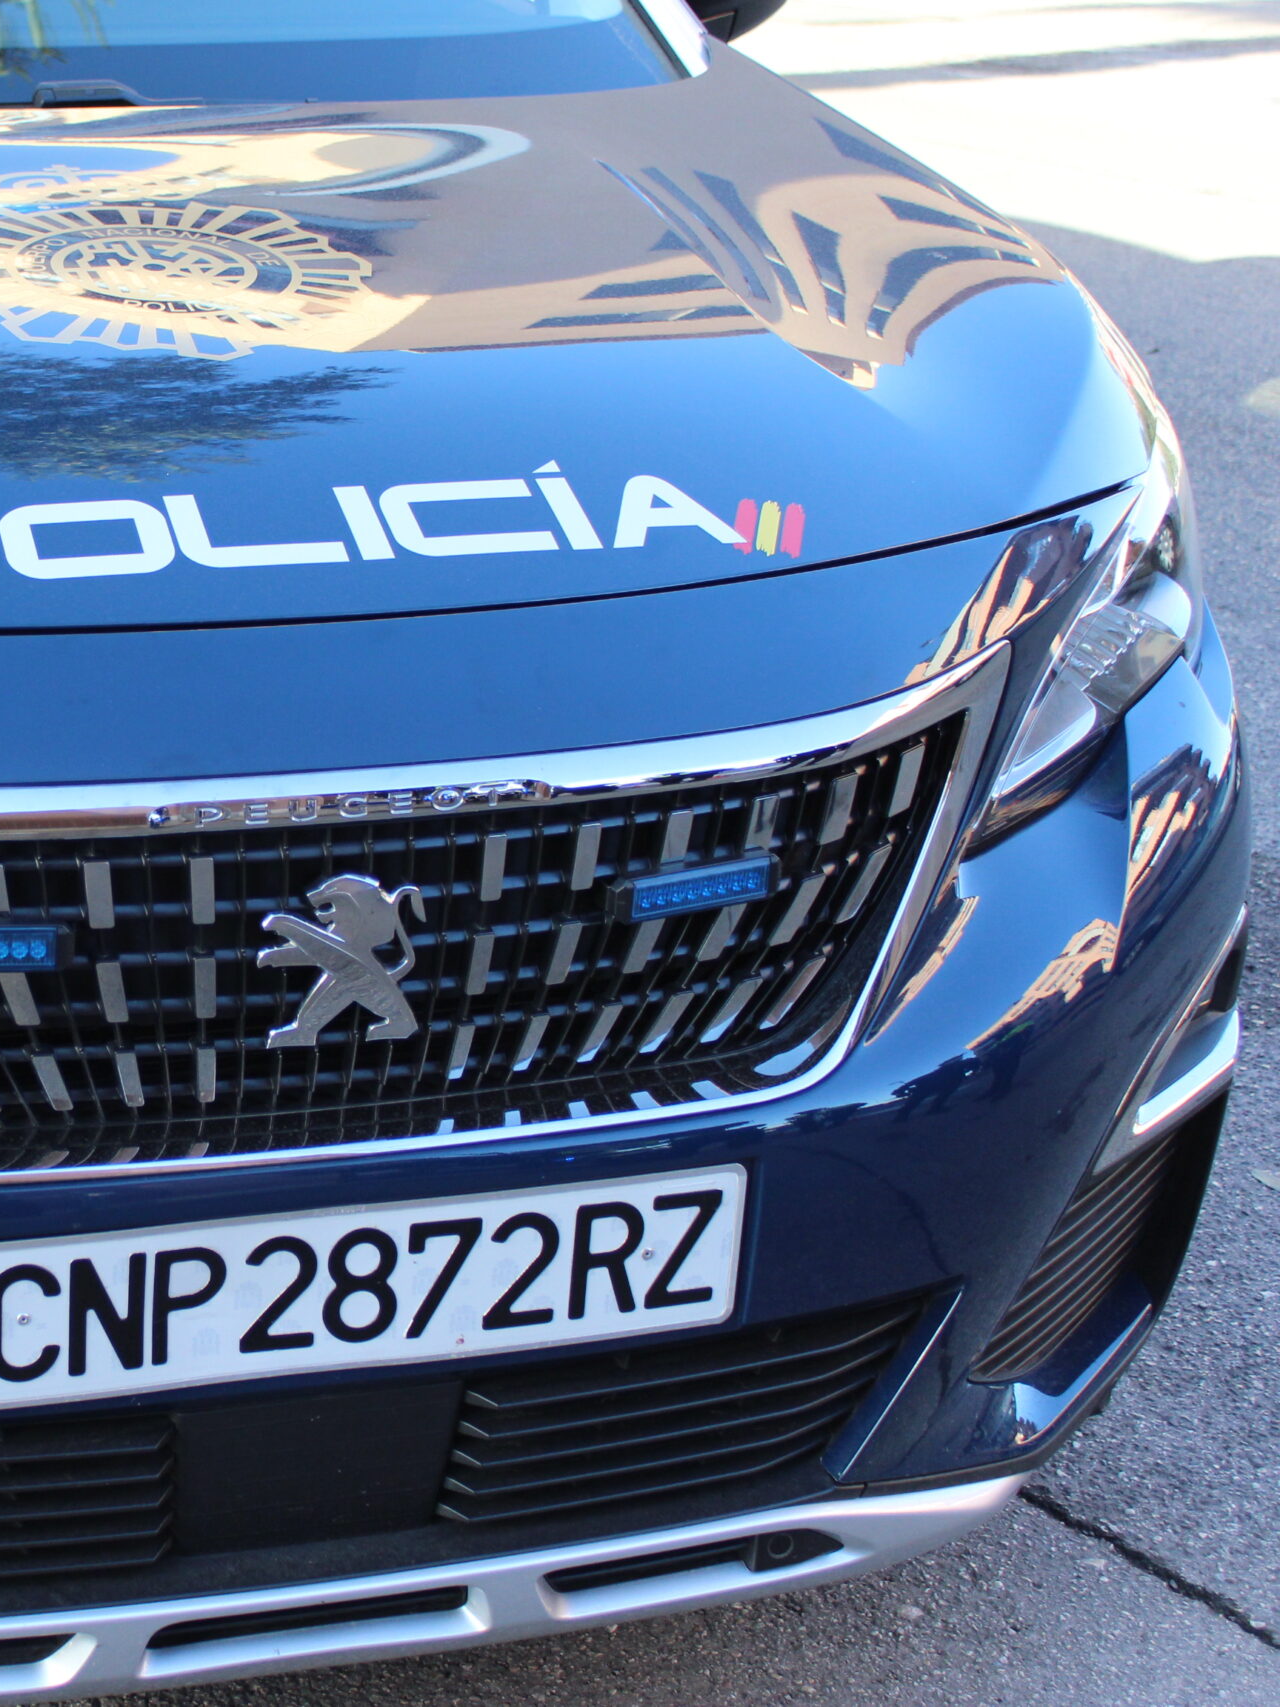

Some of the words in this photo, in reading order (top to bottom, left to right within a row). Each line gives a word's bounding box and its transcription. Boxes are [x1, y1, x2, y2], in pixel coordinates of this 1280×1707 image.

[81, 228, 231, 248] NACIONAL
[246, 251, 281, 266] DE
[194, 782, 517, 828] PEUGEOT
